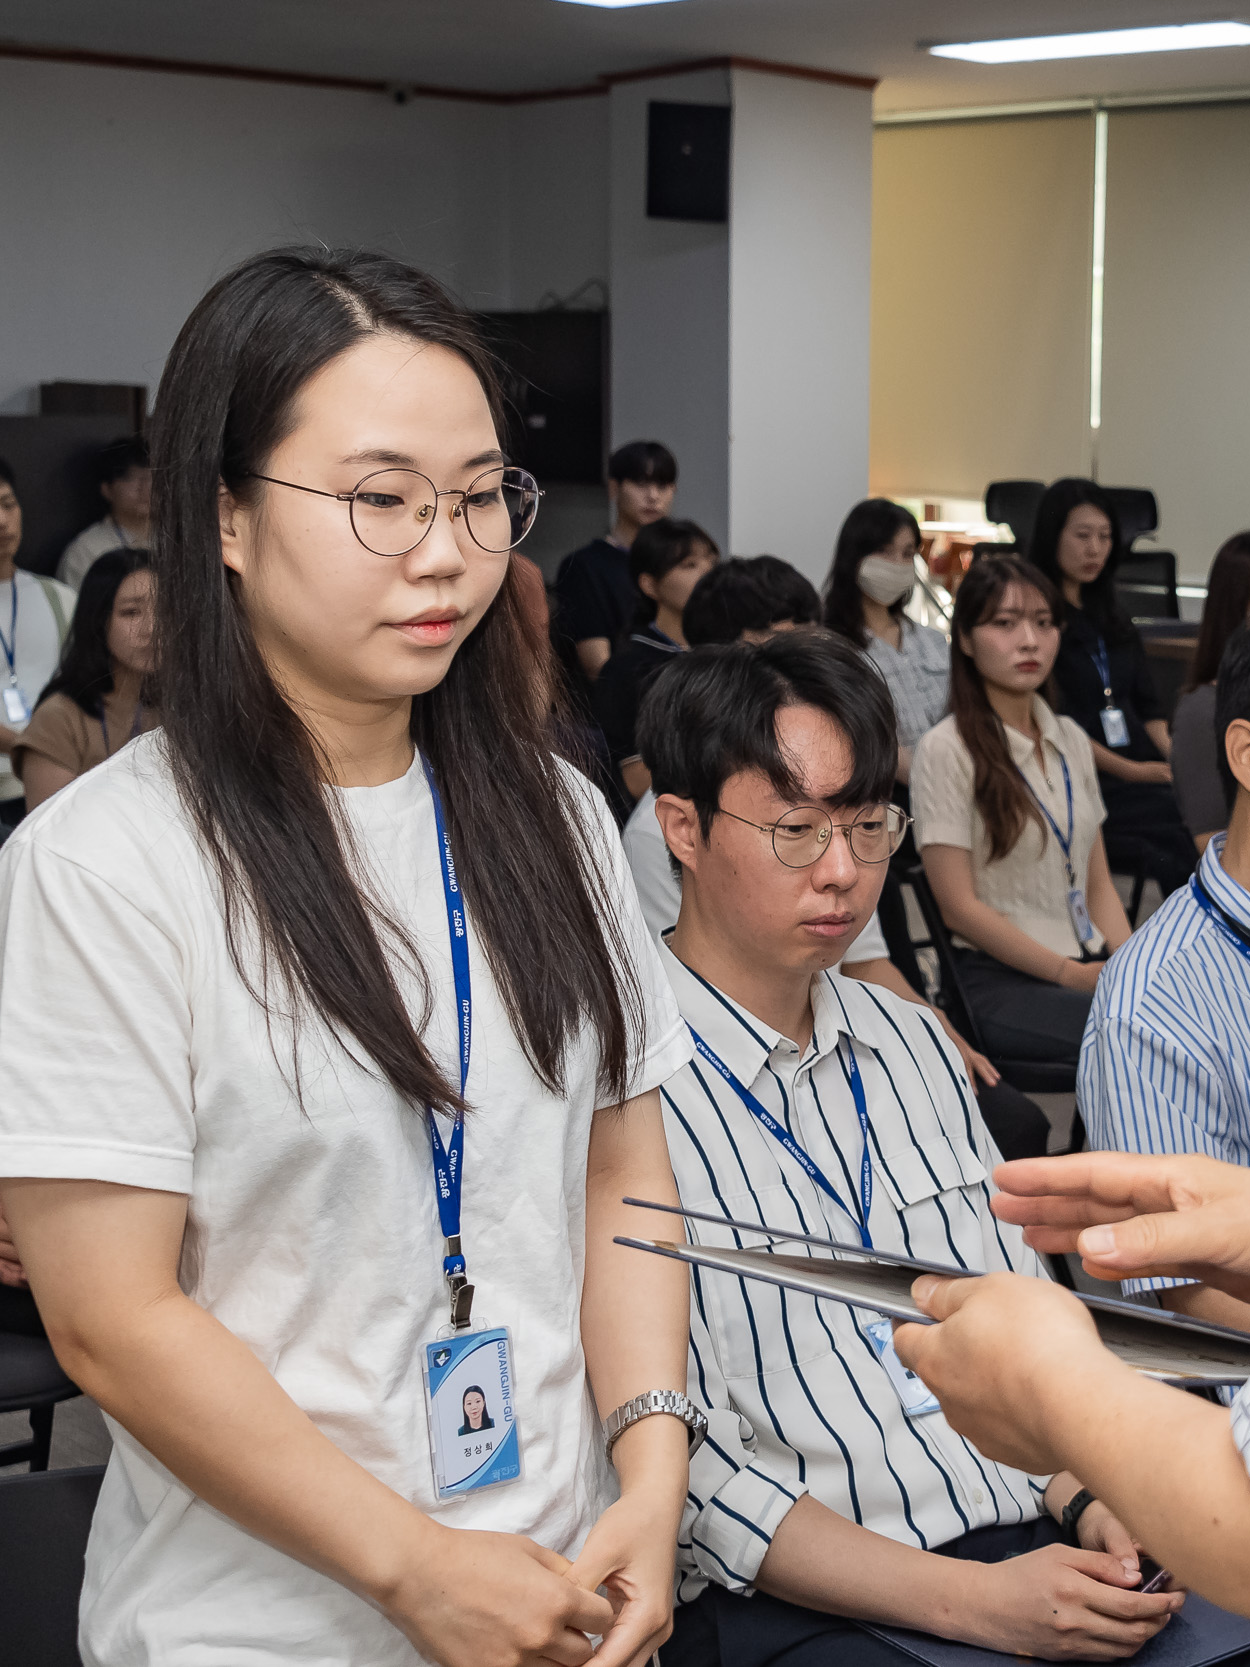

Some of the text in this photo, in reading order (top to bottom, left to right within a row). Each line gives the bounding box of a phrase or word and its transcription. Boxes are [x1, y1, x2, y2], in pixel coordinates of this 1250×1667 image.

[453, 909, 465, 938] 광진구
[462, 999, 470, 1064] GWANGJIN-GU
[696, 1041, 732, 1079] GWANGJIN-GU
[782, 1137, 817, 1176] GWANGJIN-GU
[438, 1168, 451, 1199] 광진구
[497, 1340, 513, 1422] GWANGJIN-GU
[463, 1441, 494, 1458] 정상희
